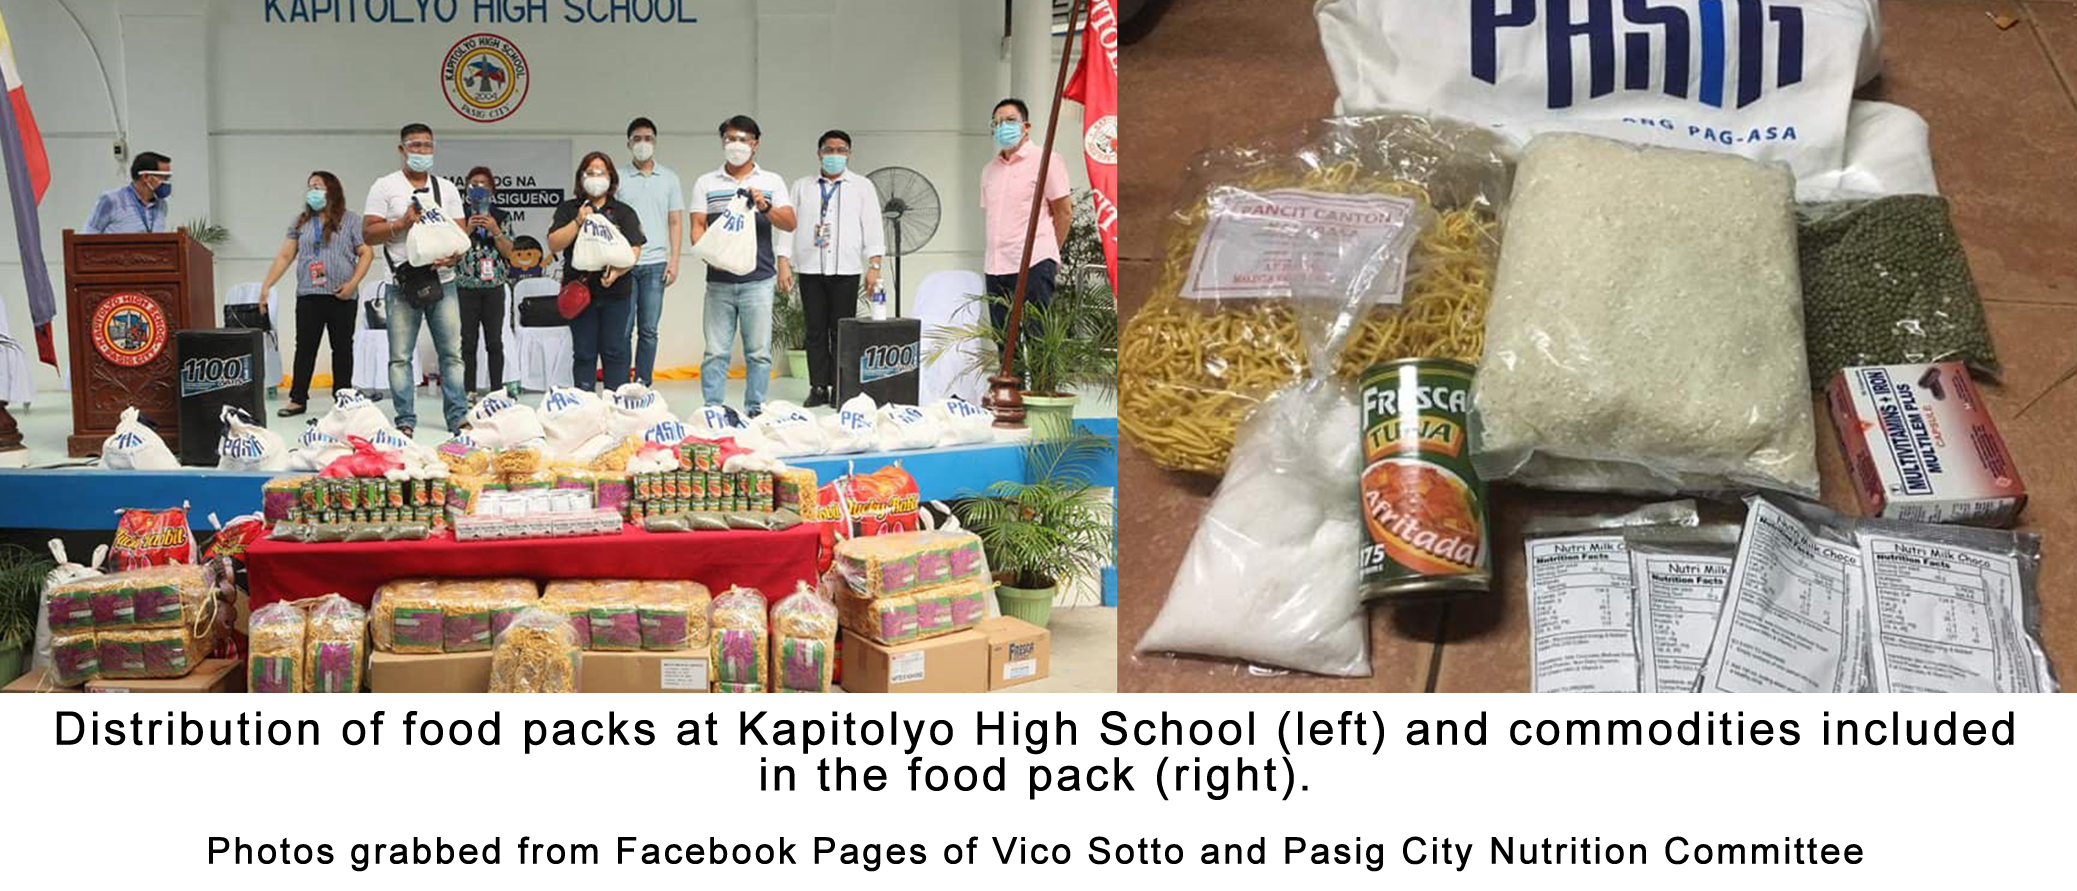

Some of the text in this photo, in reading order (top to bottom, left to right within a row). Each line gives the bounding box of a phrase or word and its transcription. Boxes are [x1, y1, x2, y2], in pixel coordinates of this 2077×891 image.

[265, 0, 698, 23] KAPITOLYO HIGH SCHOOL
[1688, 125, 1797, 145] PAG-ASA
[517, 176, 536, 187] NA
[489, 190, 560, 204] ASIGUEÑO
[1314, 207, 1392, 223] CANTON
[864, 344, 913, 369] 1100
[183, 357, 243, 382] 1100
[1866, 371, 1892, 396] IRON
[1363, 386, 1468, 430] FRSCA
[1896, 383, 1918, 411] PLUS
[1880, 404, 1928, 490] MULTIVITAMINS
[1366, 490, 1476, 567] Afritada
[1555, 543, 1586, 553] Nutri
[1590, 543, 1613, 551] Milk
[1895, 543, 1927, 556] Nutri
[1930, 548, 1954, 560] Milk
[1668, 563, 1729, 574] Nutri Milk
